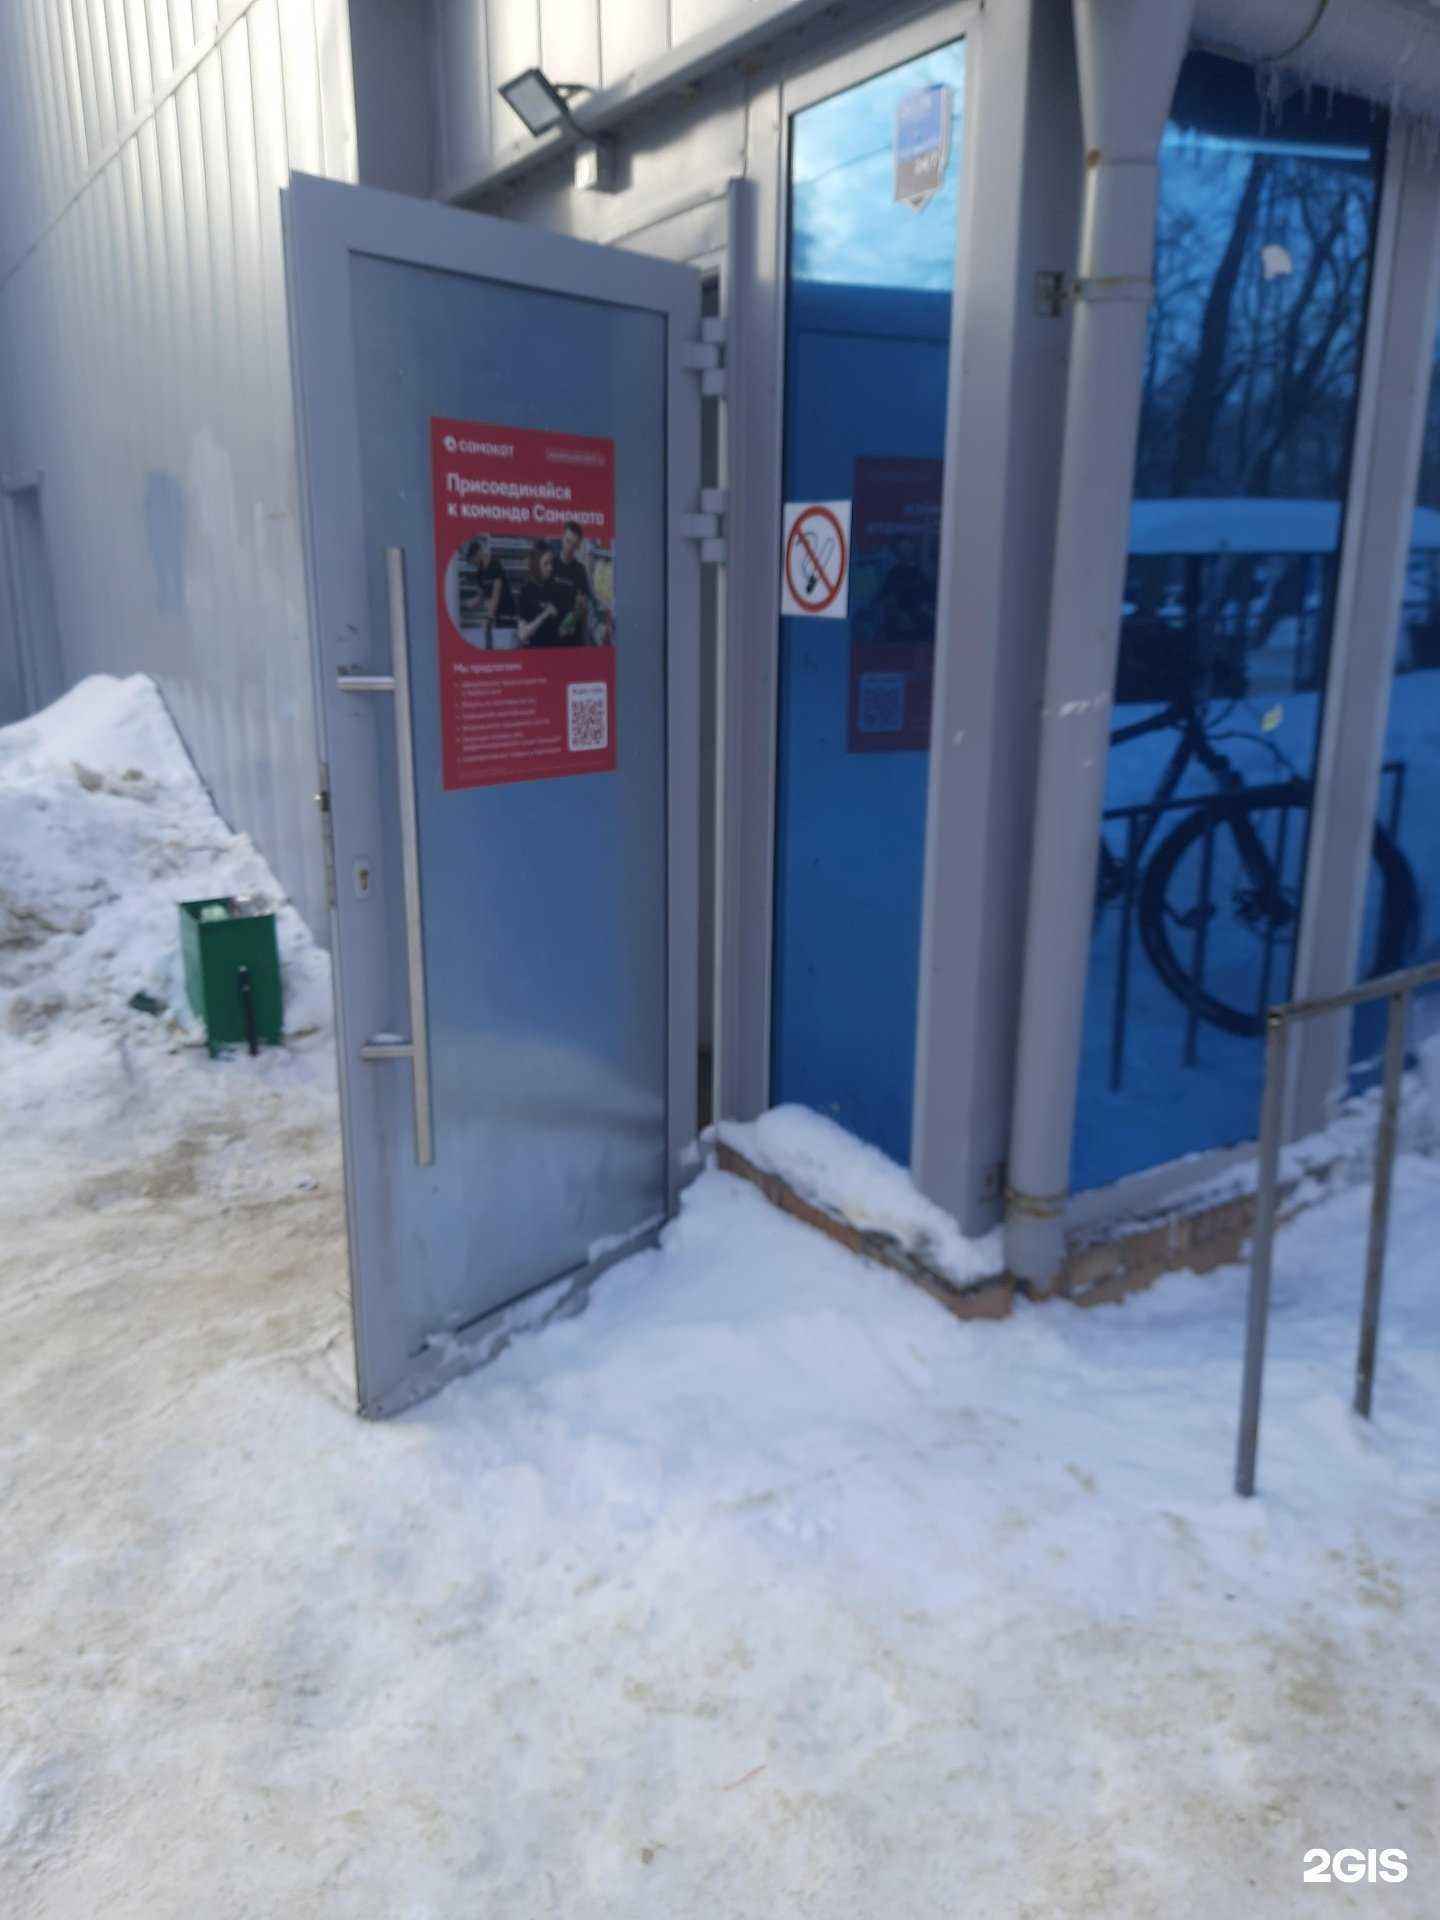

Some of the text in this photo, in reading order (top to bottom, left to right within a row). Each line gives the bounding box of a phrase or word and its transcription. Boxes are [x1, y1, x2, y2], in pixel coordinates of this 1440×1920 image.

[447, 472, 572, 501] Присоединяйся
[448, 503, 459, 517] к
[462, 504, 530, 522] команде
